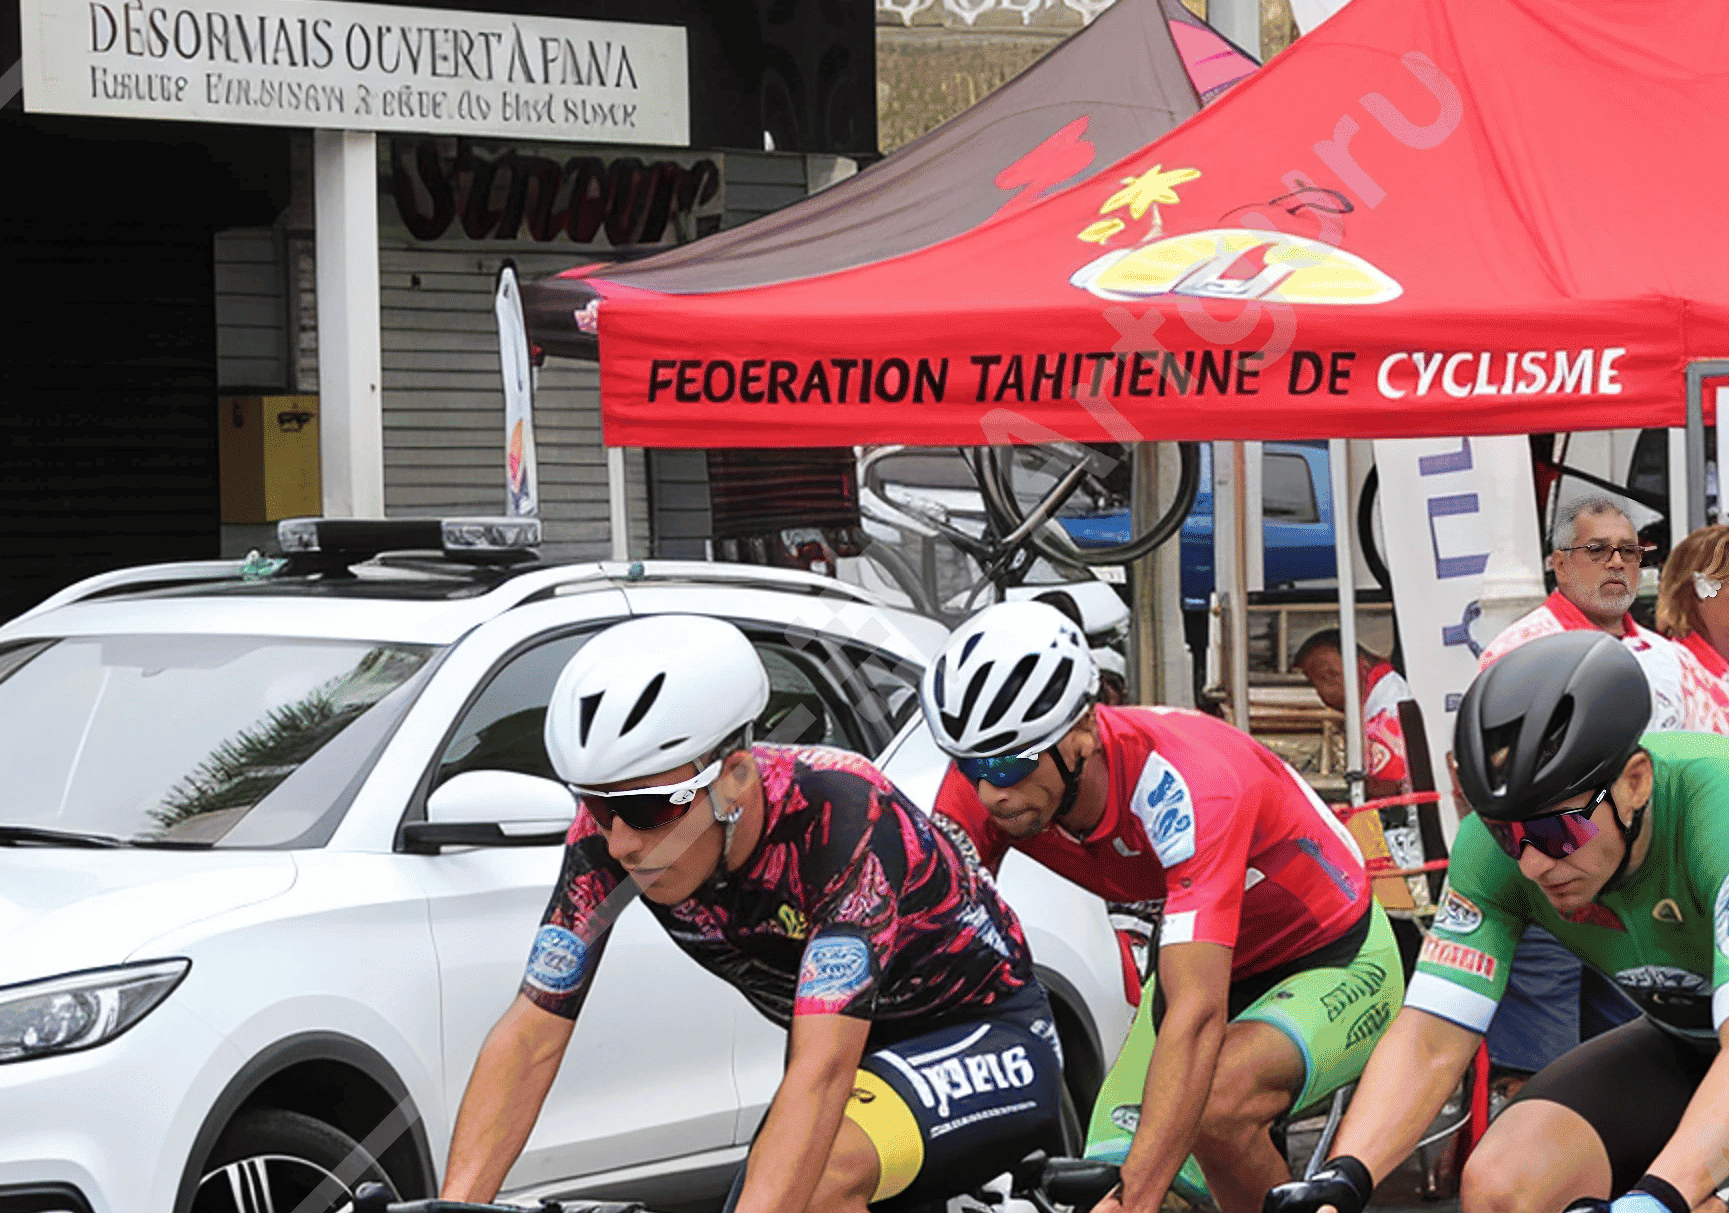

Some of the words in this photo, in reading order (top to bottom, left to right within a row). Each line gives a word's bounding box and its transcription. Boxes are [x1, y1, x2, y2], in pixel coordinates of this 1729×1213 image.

[970, 348, 1265, 403] TAHITIENNE
[1289, 351, 1357, 396] DE
[1377, 346, 1627, 399] CYCLISME
